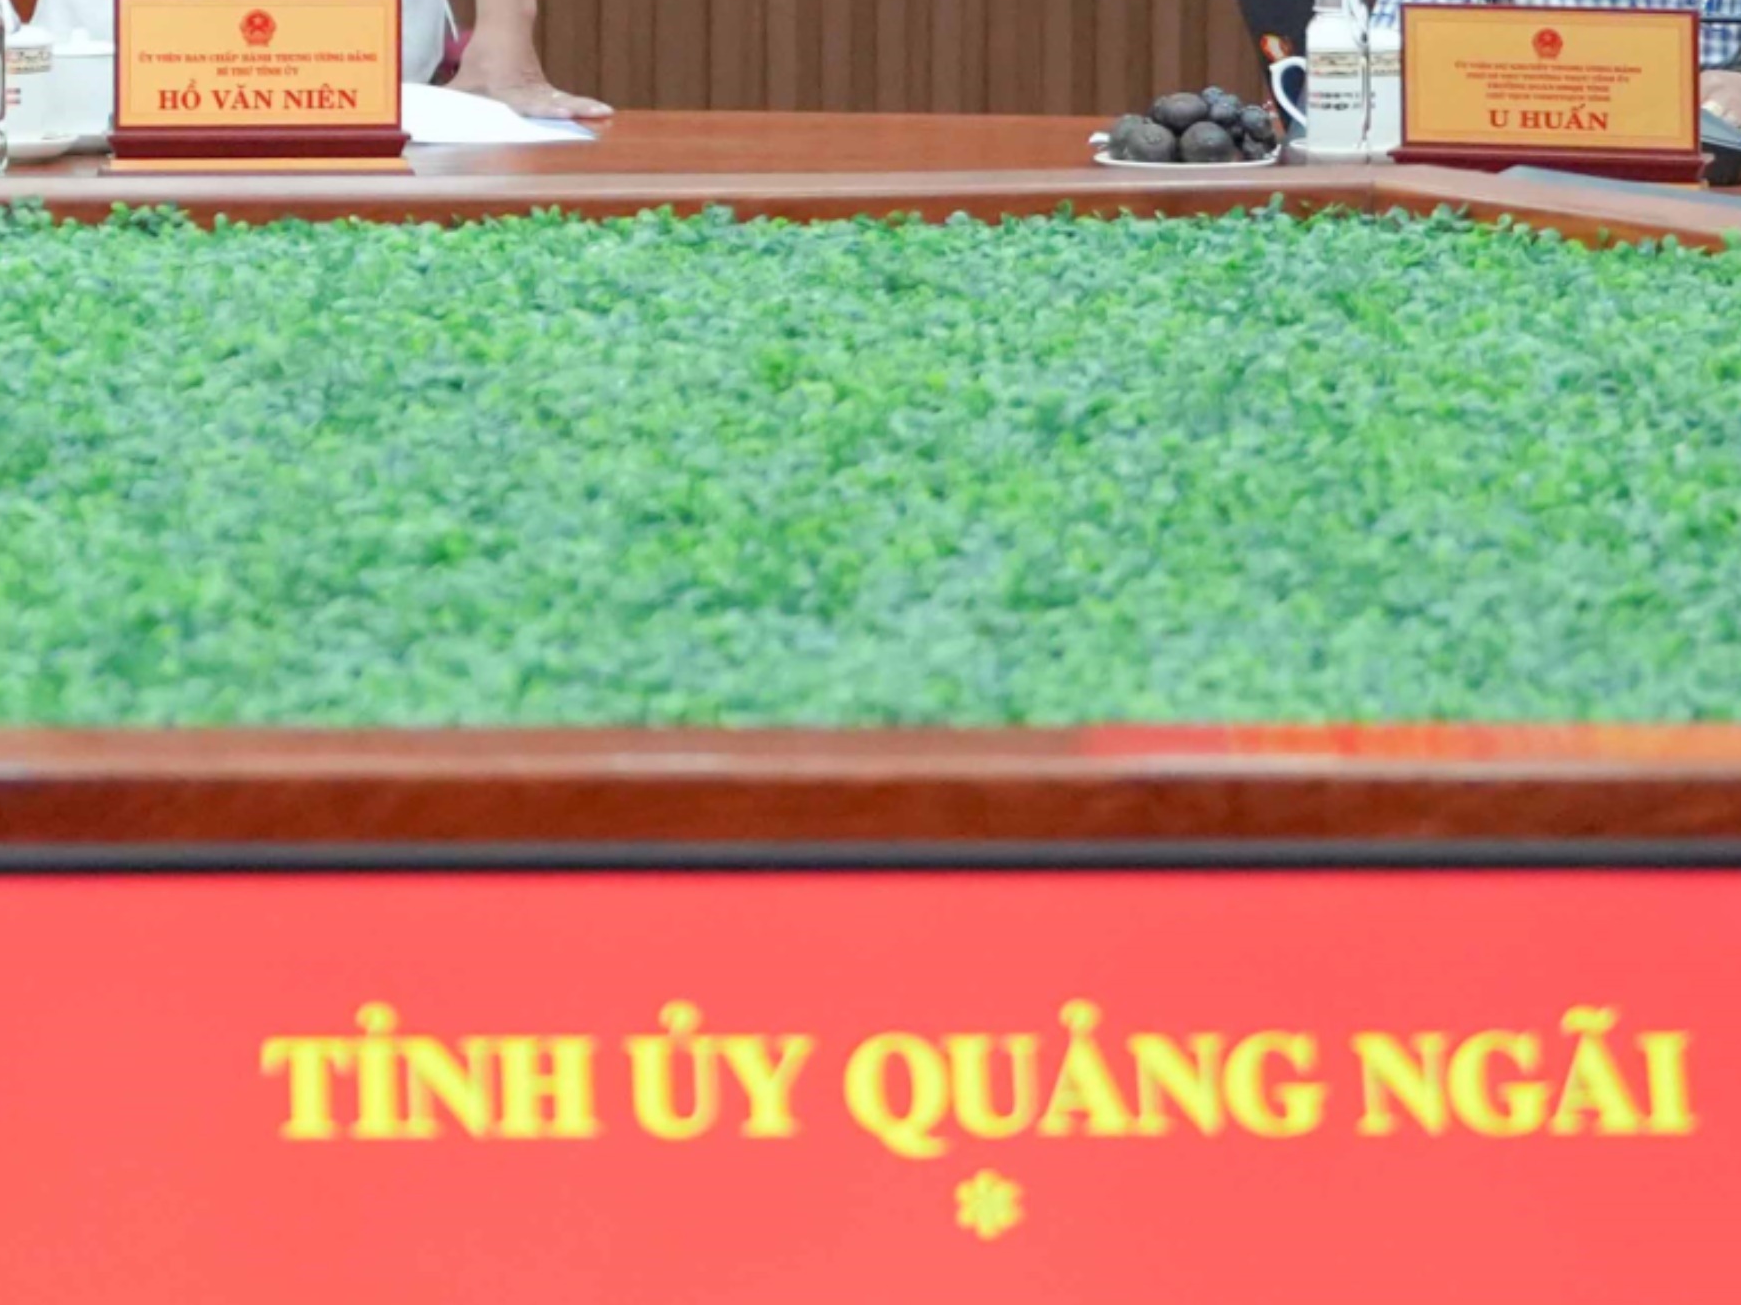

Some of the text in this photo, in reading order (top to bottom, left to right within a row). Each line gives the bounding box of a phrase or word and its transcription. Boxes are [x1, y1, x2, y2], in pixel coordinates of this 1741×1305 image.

[210, 84, 274, 111] VĂN
[282, 82, 359, 111] NIÊN
[1489, 103, 1609, 131] U HUẤN
[261, 998, 1698, 1160] TỈNH ỦY QUẢNG NGÃI
